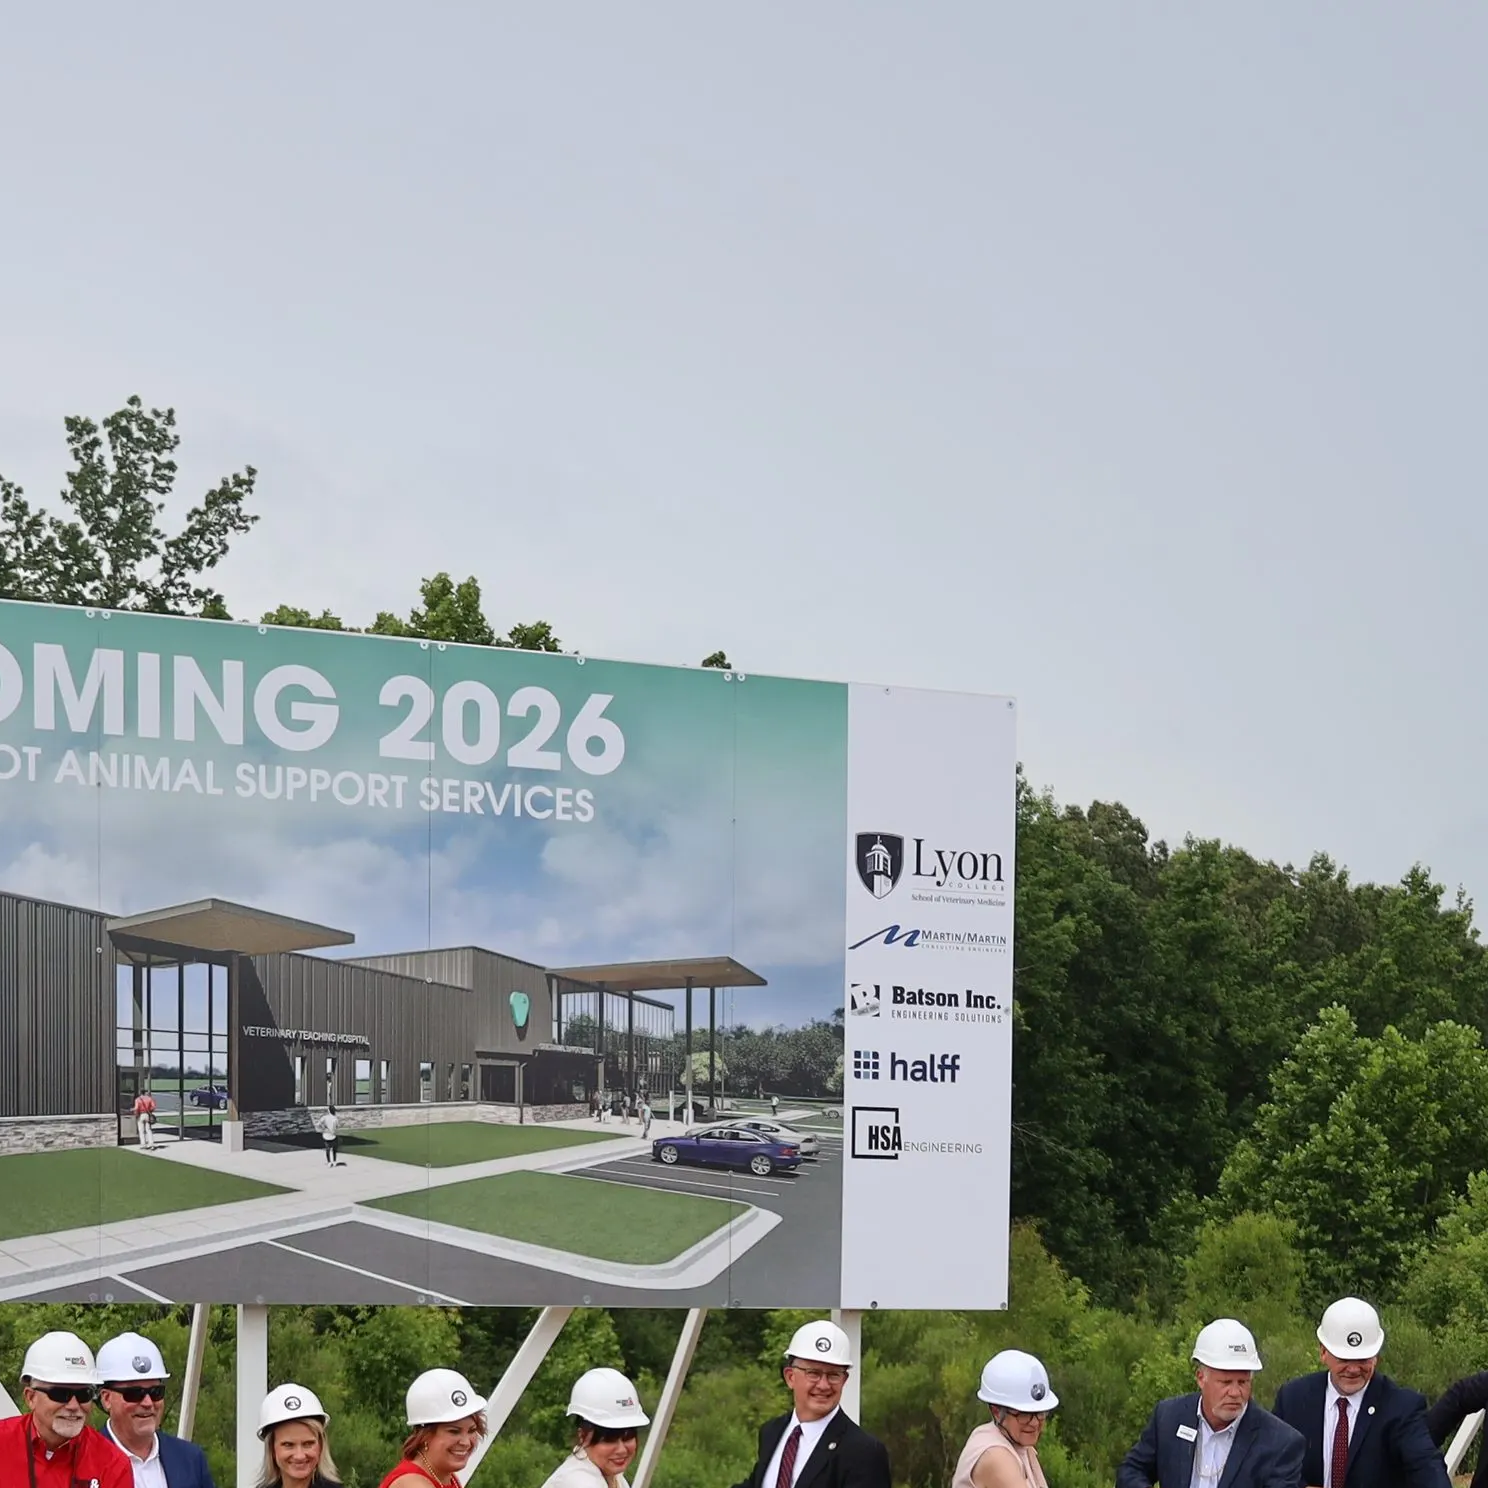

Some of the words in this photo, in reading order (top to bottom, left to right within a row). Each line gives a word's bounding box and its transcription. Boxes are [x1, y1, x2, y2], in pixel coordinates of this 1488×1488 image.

[378, 675, 626, 775] 2026
[55, 749, 223, 796] ANIMAL
[234, 763, 407, 810] SUPPORT
[419, 777, 594, 823] SERVICES
[912, 838, 1004, 887] Lyon
[949, 882, 1004, 891] COLLEGE
[912, 893, 932, 902] School
[942, 895, 974, 905] Veterinary
[977, 898, 1005, 907] Medicine
[892, 986, 959, 1008] Batson
[966, 990, 1002, 1010] Inc.
[891, 1010, 949, 1021] ENGINEERING
[955, 1013, 1002, 1023] SOLUTIONS
[242, 1025, 296, 1039] VETERINARY
[298, 1030, 336, 1042] TEACHING
[337, 1033, 370, 1045] HOSPITAL
[890, 1052, 960, 1083] halff
[868, 1126, 902, 1151] HSA
[903, 1142, 983, 1153] ENGINEERING
